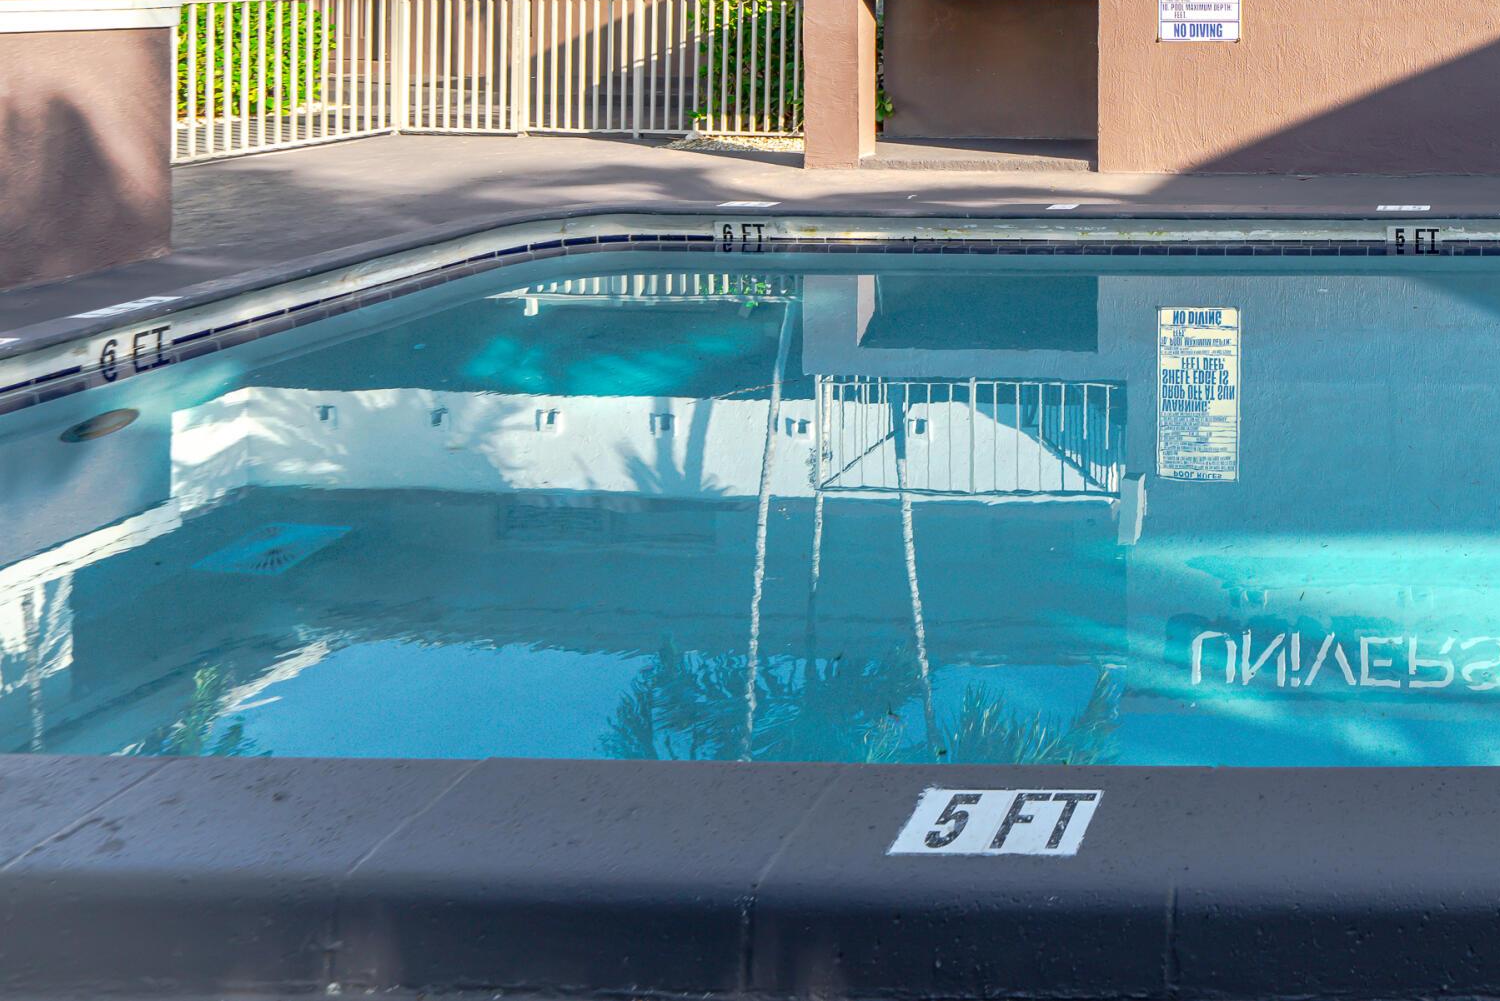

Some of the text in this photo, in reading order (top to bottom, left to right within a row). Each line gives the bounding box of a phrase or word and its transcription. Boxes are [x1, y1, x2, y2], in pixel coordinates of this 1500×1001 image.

[1171, 3, 1184, 11] POOL
[1185, 3, 1212, 11] MAXIMUM
[1174, 23, 1223, 37] NO DIVING
[924, 792, 1097, 849] 5 FT
